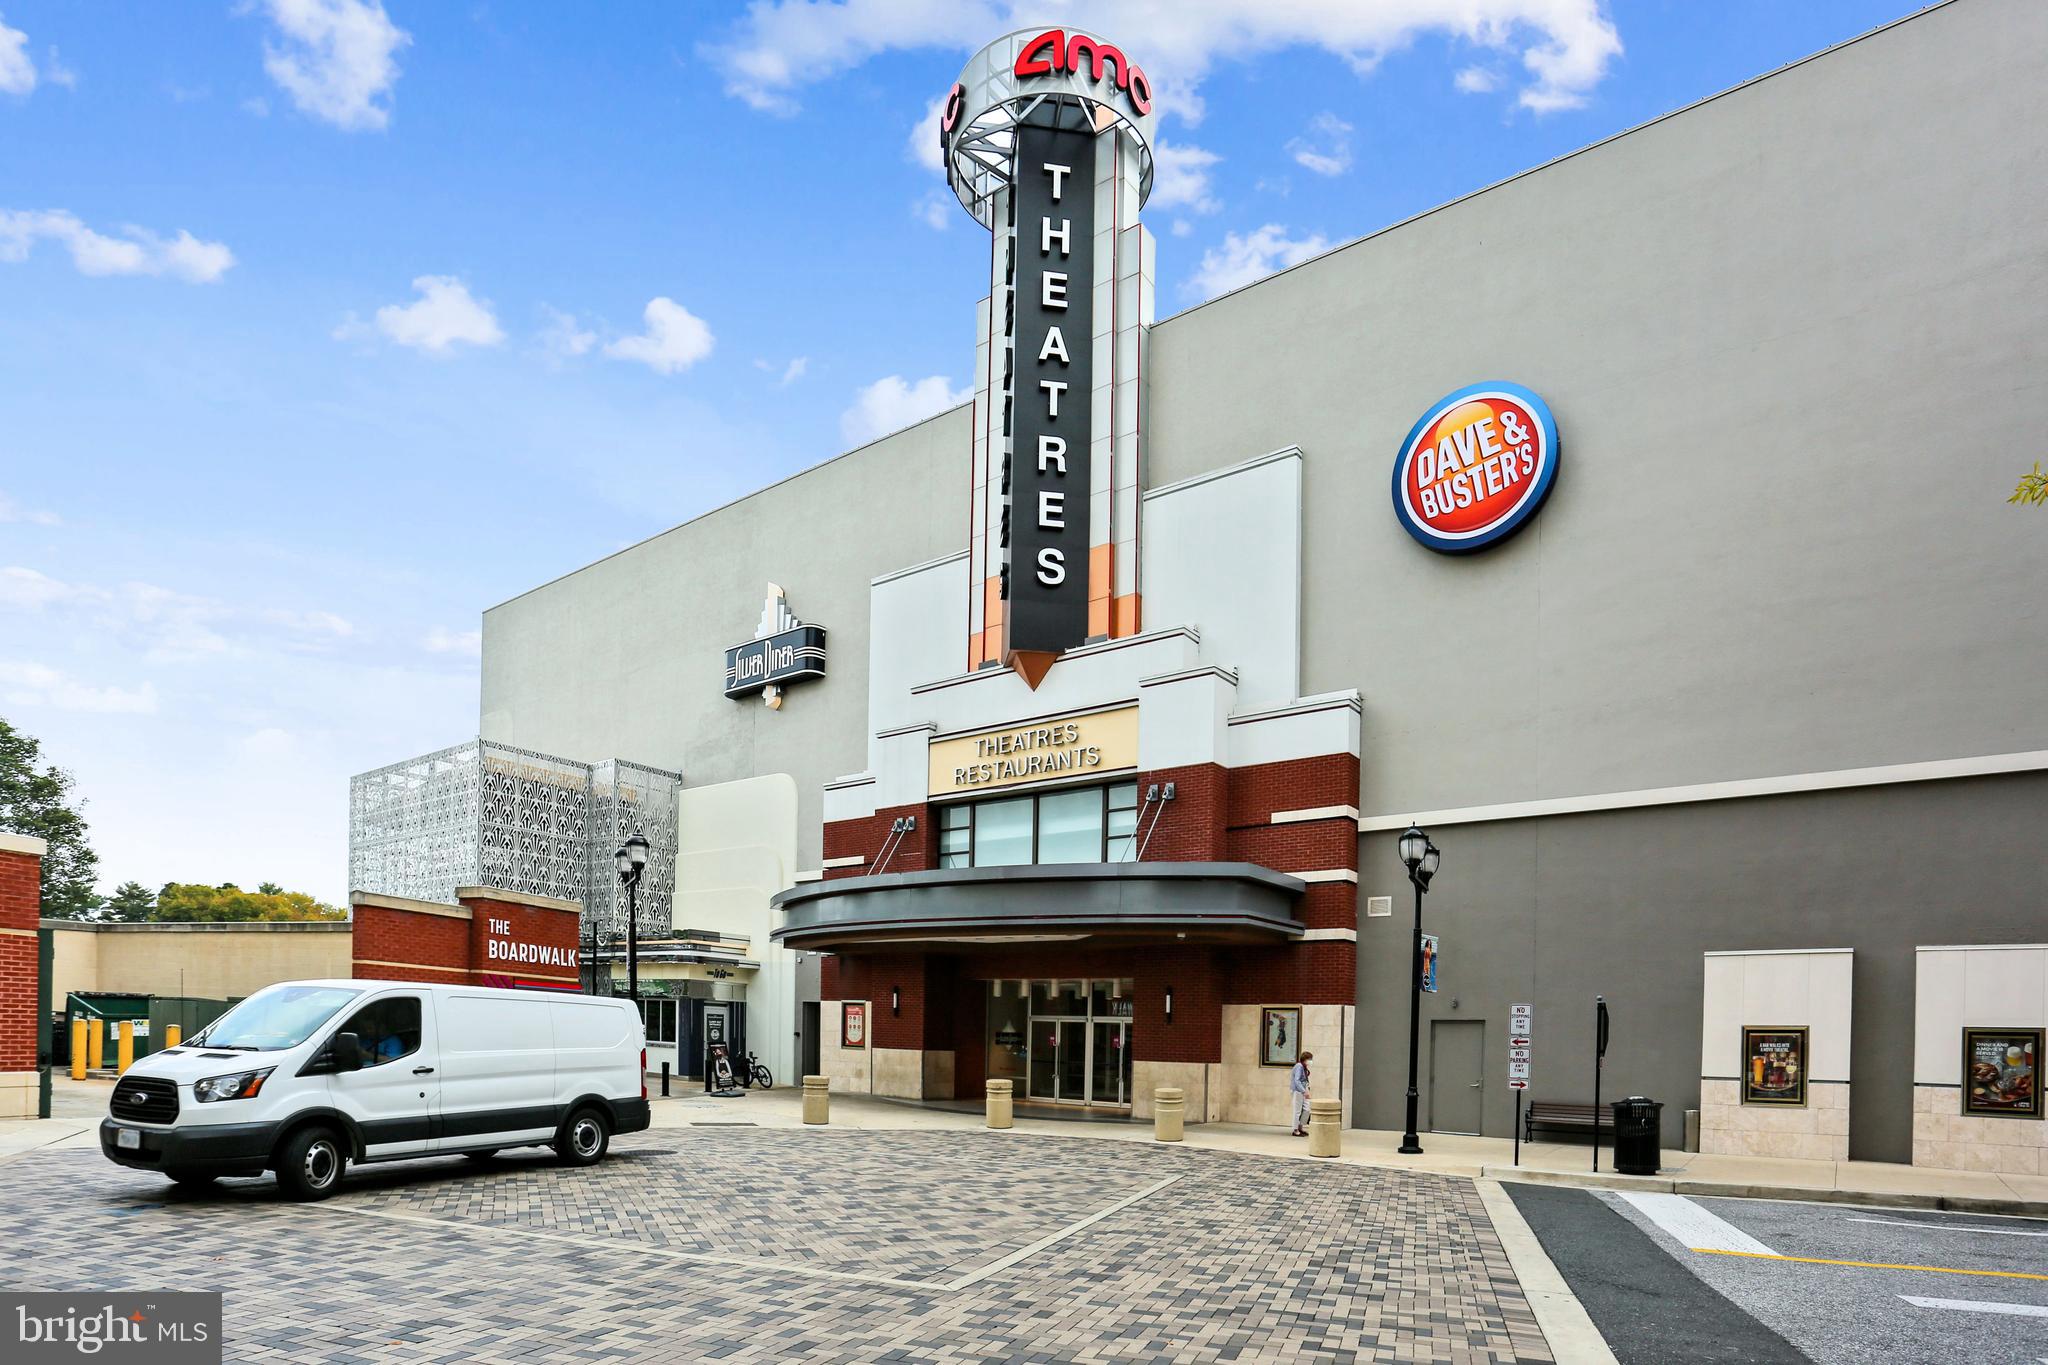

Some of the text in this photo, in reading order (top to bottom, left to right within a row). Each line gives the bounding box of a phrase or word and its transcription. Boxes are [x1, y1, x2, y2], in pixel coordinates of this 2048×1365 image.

[1036, 162, 1072, 586] THEATRES
[1416, 410, 1531, 489] DAVE &
[1419, 442, 1534, 519] BUSTER'S
[975, 722, 1079, 758] THEATRES
[954, 745, 1101, 786] RESTAURANTS
[488, 918, 511, 936] THE
[488, 939, 577, 968] BOARDWALK
